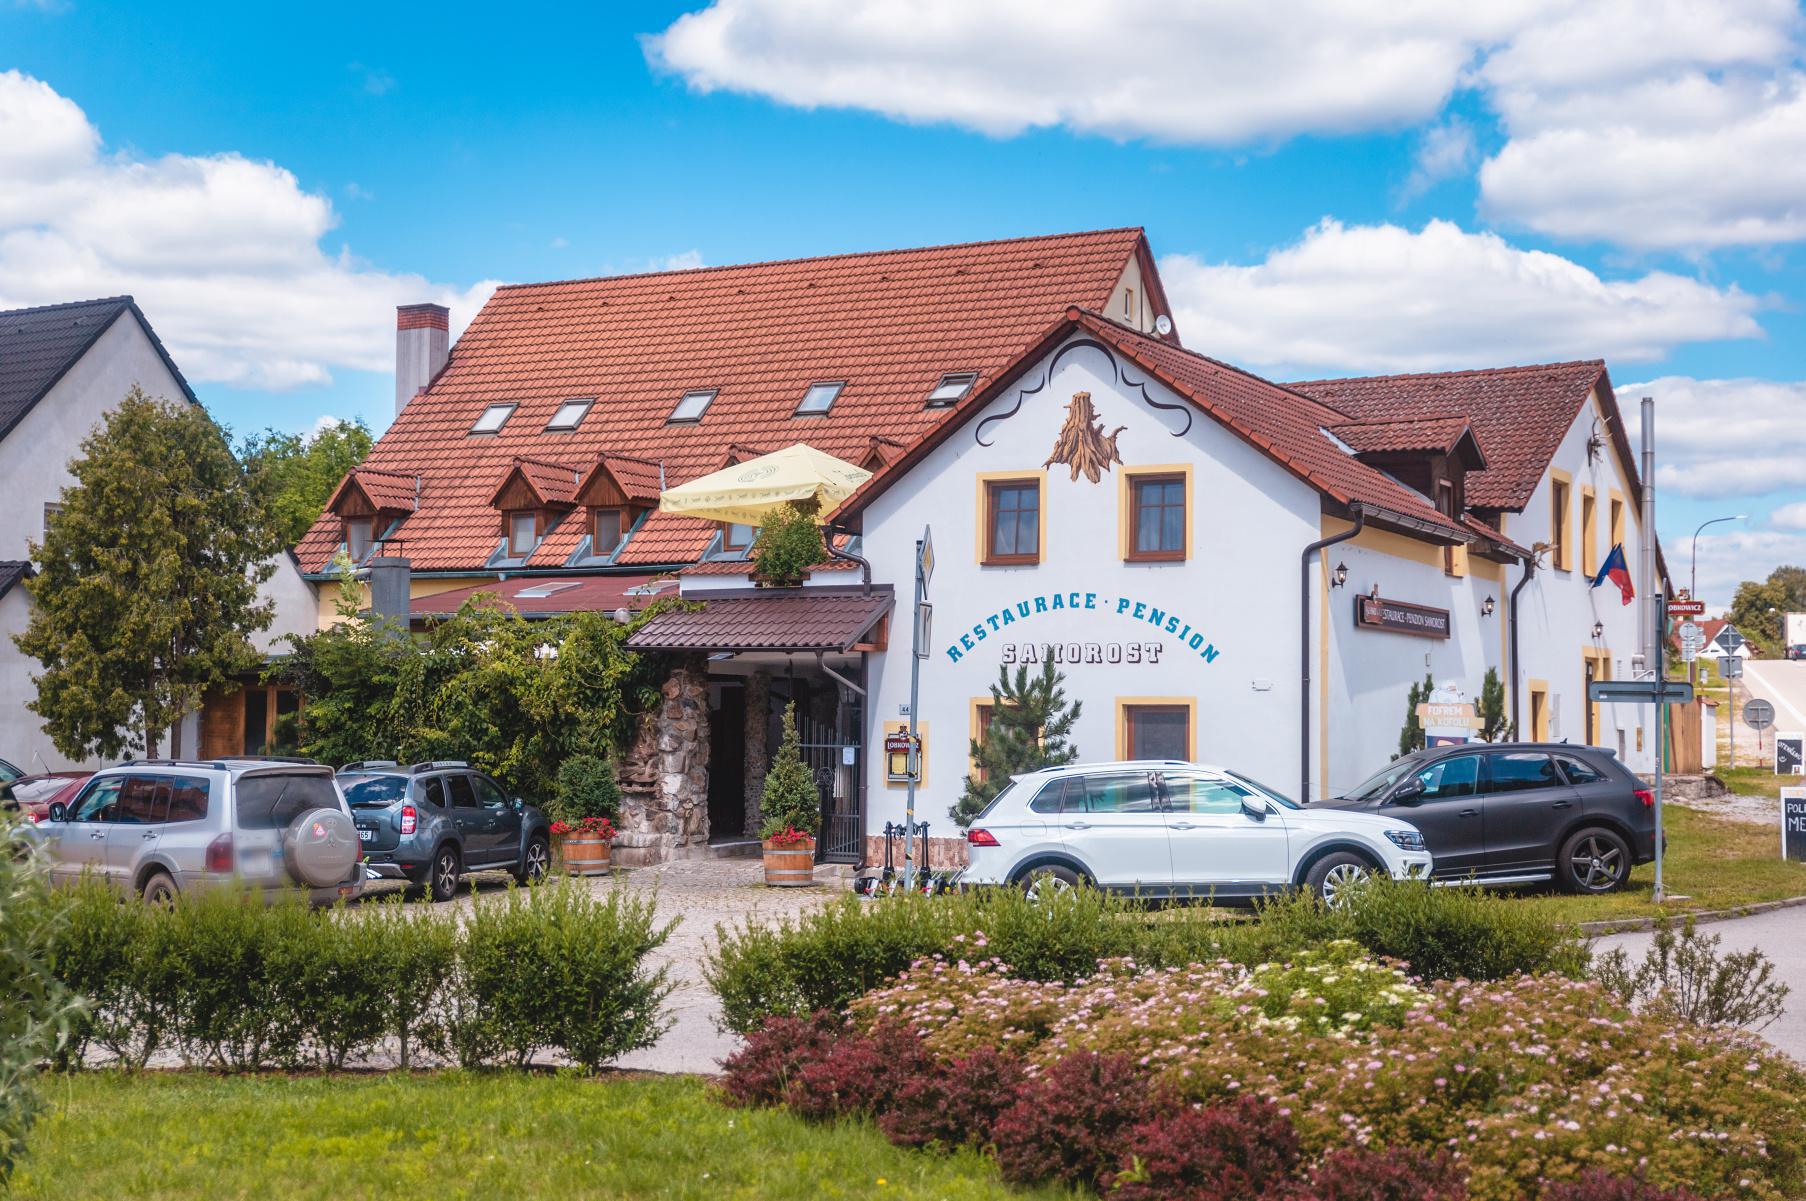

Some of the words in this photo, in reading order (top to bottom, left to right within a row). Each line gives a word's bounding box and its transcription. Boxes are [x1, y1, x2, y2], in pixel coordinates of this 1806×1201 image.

[1381, 608, 1405, 623] STAURACE
[946, 592, 1097, 663] RESTAURACE
[1116, 597, 1220, 664] PENSION
[1002, 642, 1163, 664] SAMOROST
[887, 741, 919, 750] LOBKOWZ
[1786, 803, 1806, 814] POL
